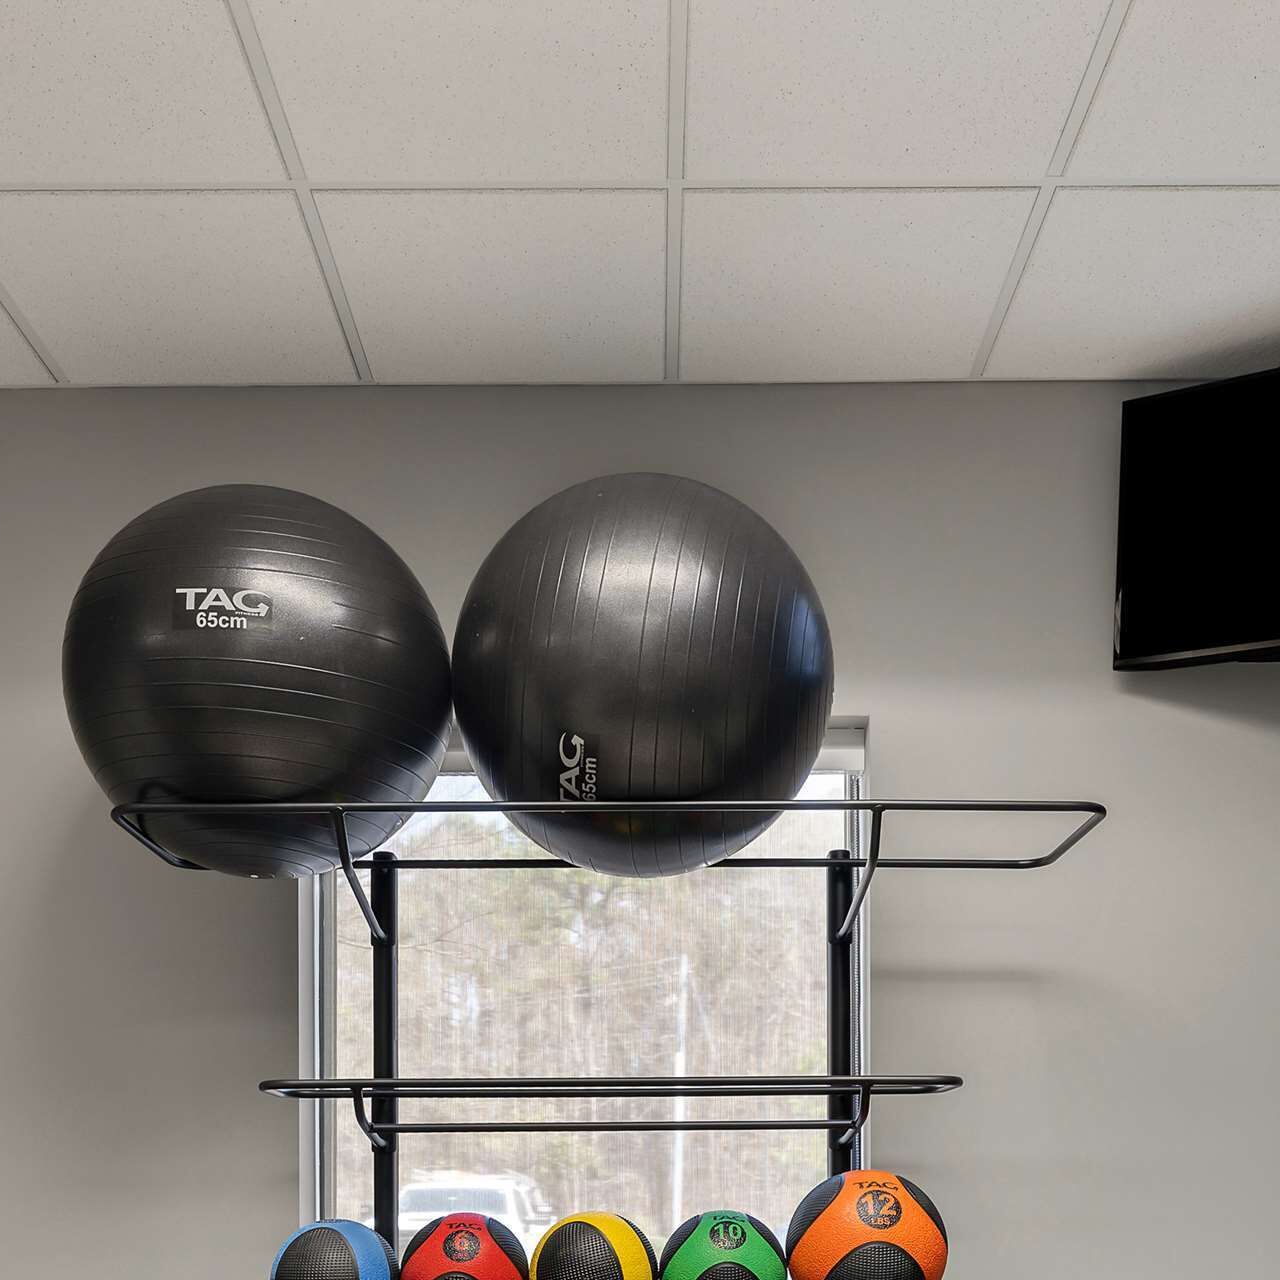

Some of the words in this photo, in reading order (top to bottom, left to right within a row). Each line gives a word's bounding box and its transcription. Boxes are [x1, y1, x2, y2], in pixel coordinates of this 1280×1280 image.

[176, 588, 270, 617] TAG
[196, 612, 247, 629] 65cm
[852, 1181, 899, 1192] TAG
[861, 1194, 898, 1216] 12
[714, 1223, 742, 1240] 10
